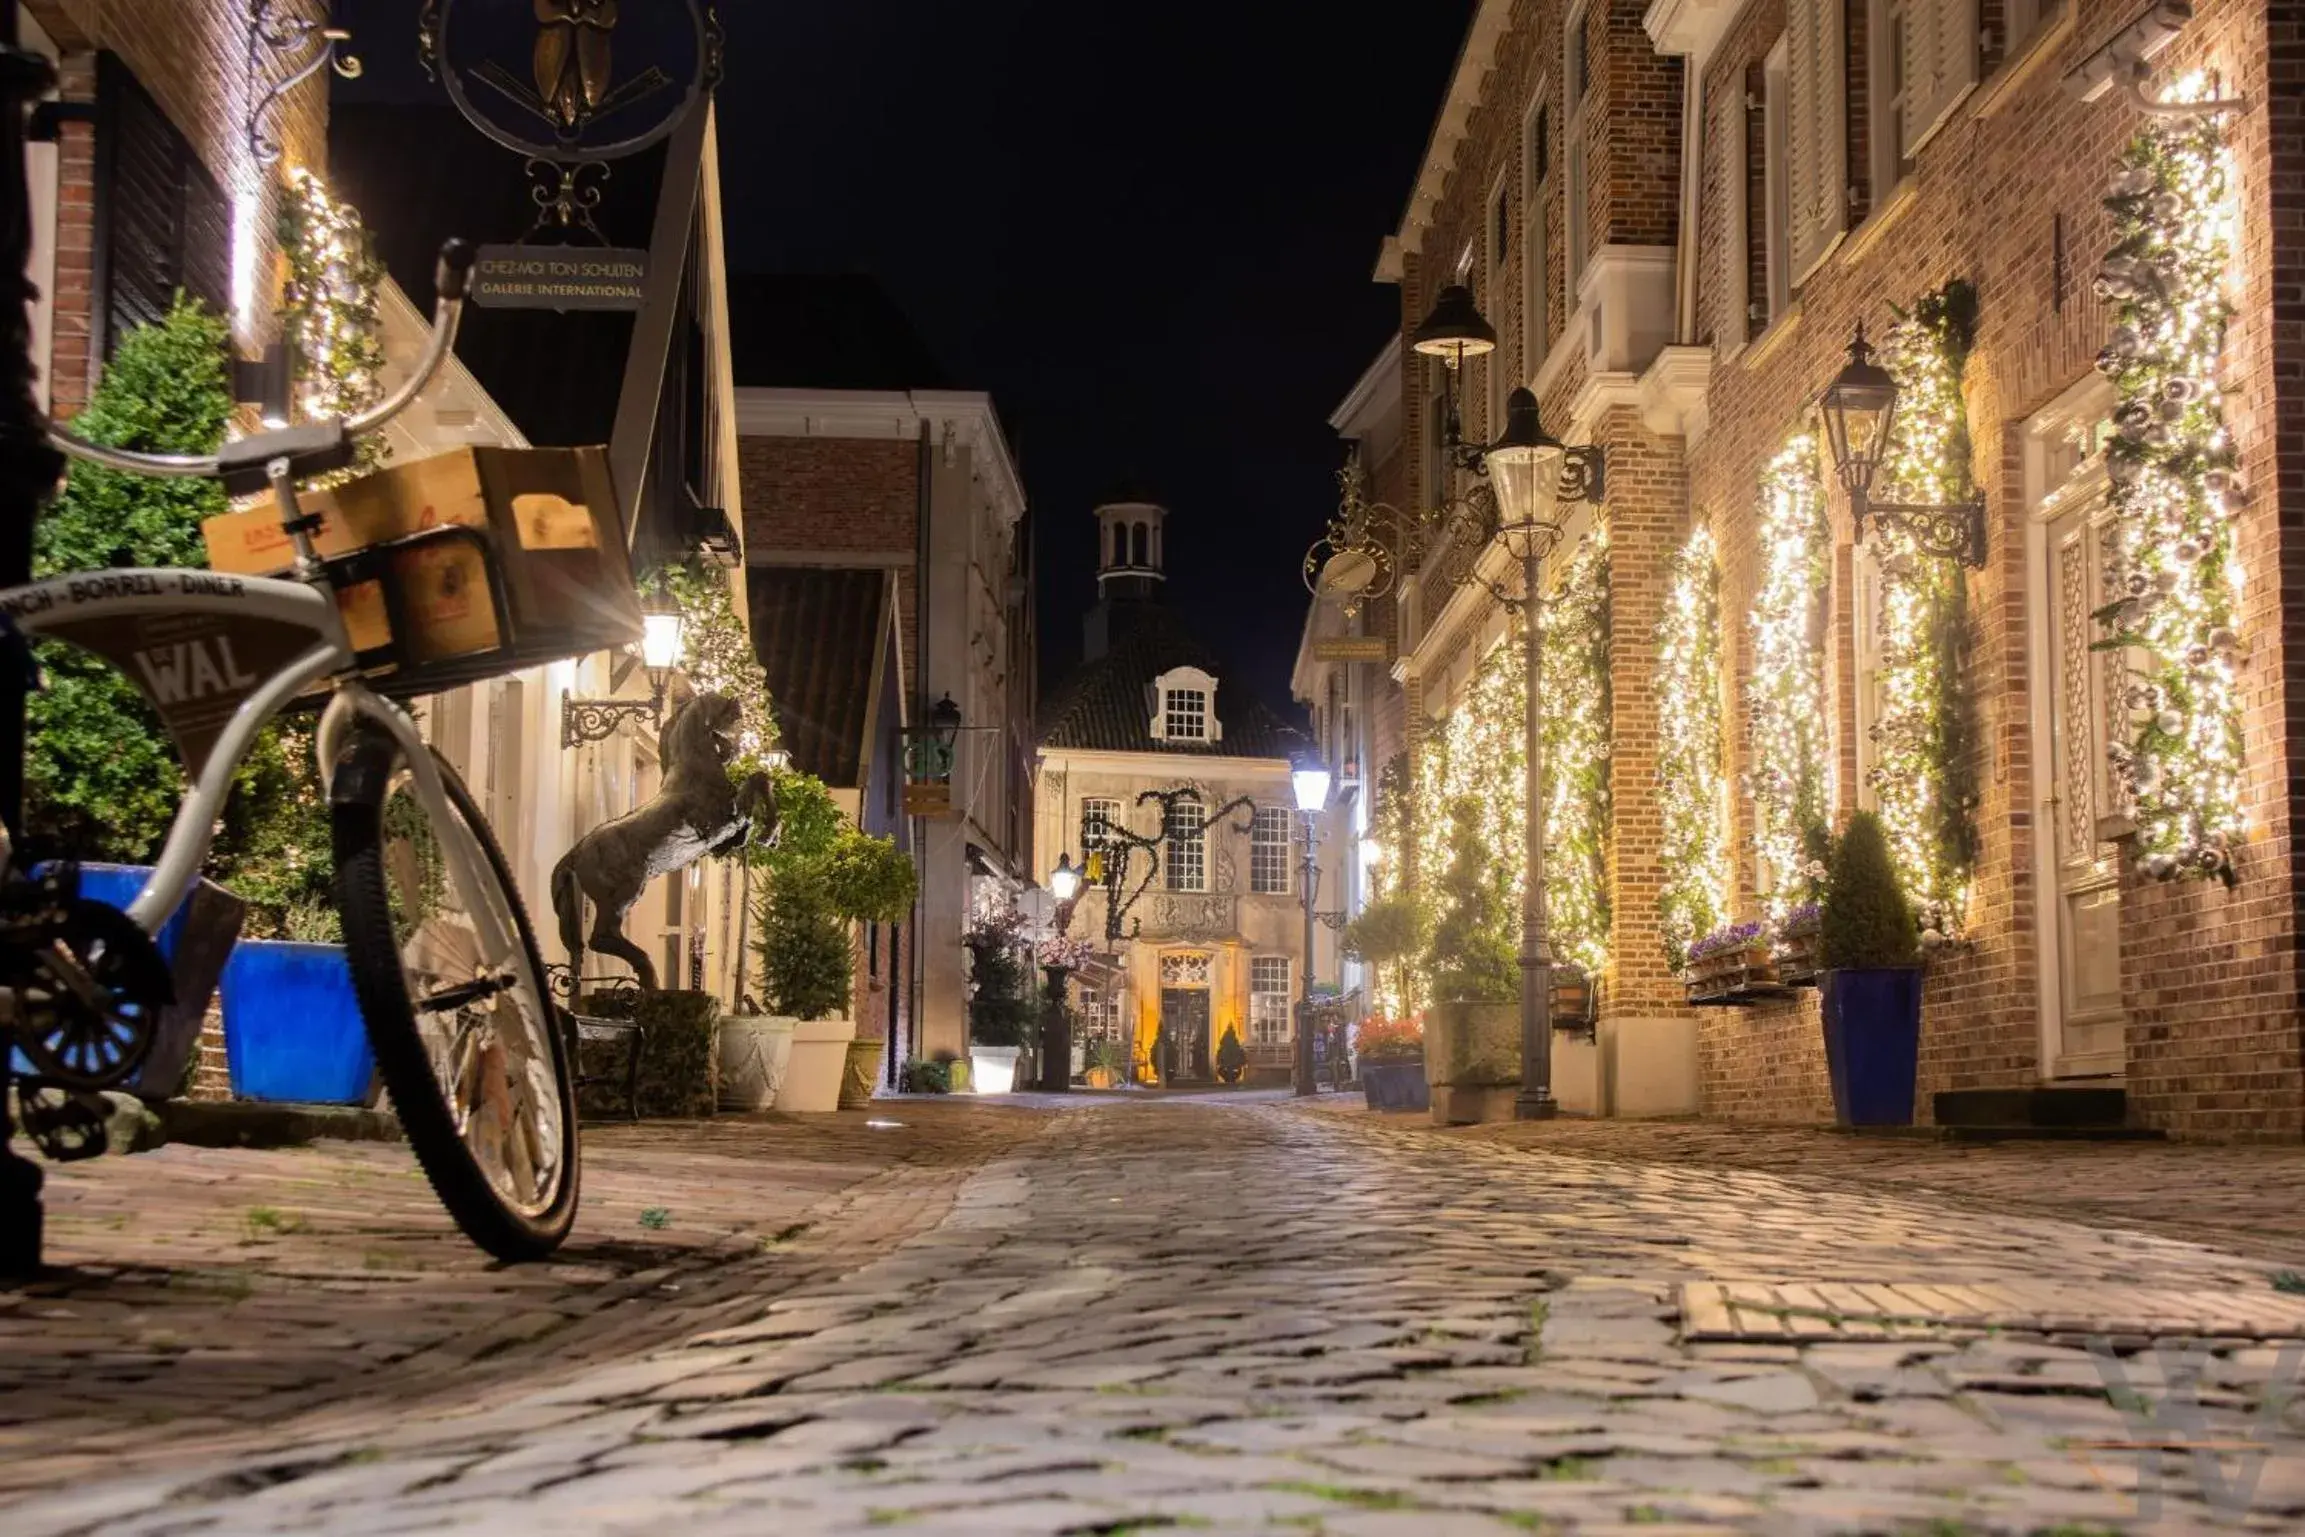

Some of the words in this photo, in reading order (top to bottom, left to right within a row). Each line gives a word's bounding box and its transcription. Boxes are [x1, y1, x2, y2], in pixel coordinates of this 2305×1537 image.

[549, 262, 578, 277] TON
[480, 282, 533, 295] GALERIE
[538, 283, 643, 299] INTERNATIONAL
[67, 574, 163, 604] BORREL
[180, 574, 246, 597] DINER
[133, 634, 257, 705] WAL
